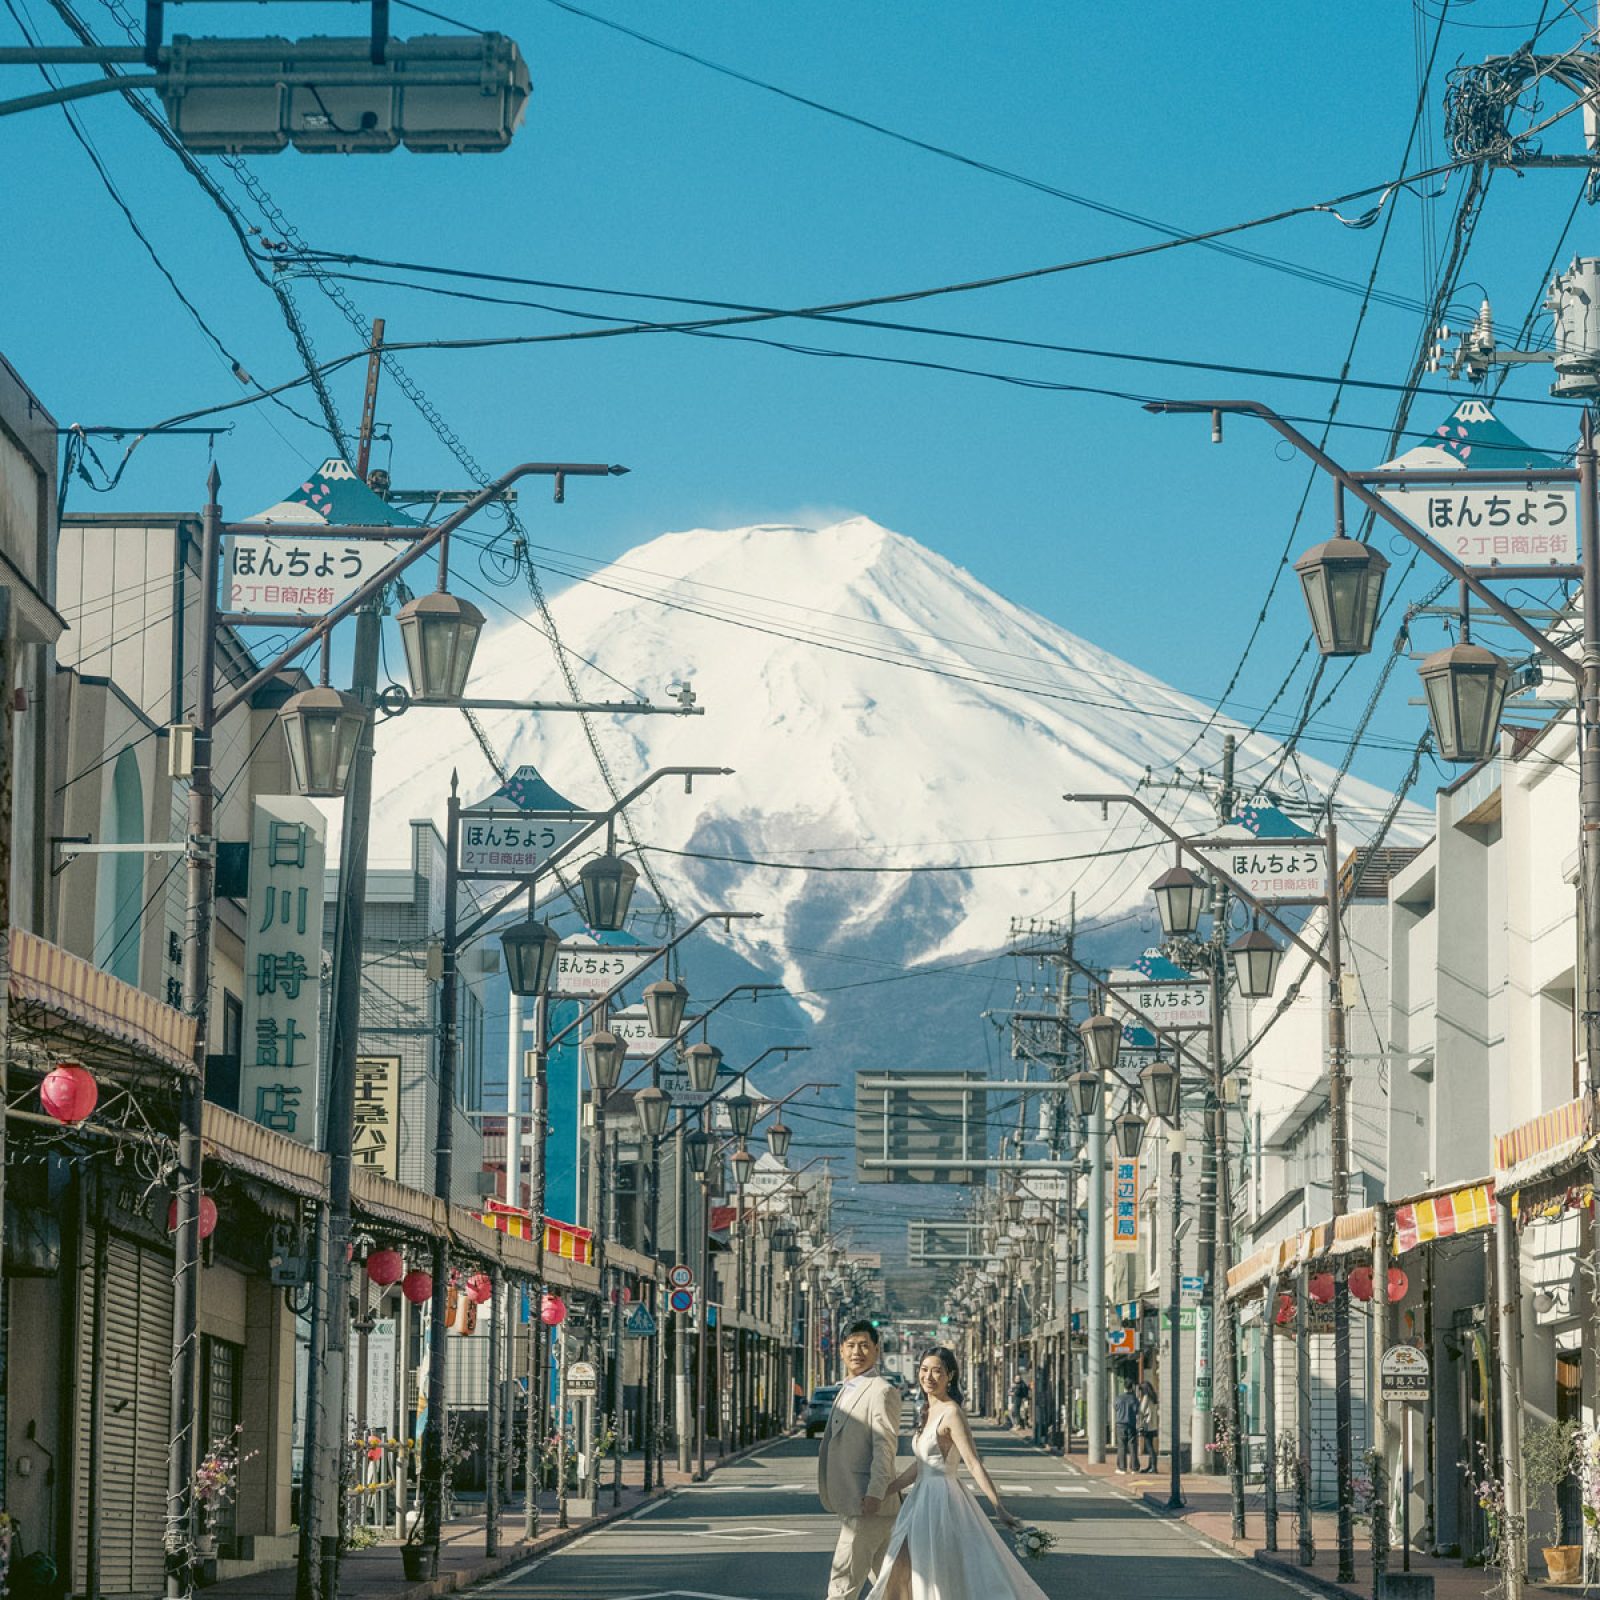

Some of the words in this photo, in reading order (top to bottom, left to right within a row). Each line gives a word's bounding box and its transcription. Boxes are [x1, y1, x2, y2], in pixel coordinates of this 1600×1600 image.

[1429, 494, 1568, 528] ほんちょう
[1457, 534, 1568, 555] 2丁目商店街
[232, 546, 362, 579] ほんちょう
[232, 584, 335, 604] 2丁目商店街
[467, 826, 556, 848] ほんちょう
[466, 852, 537, 865] 2丁目商店街
[1232, 853, 1318, 874] ほんちょう
[1251, 879, 1319, 891] 2丁目商店街
[559, 957, 625, 975] ほんちょう
[255, 821, 308, 1133] 日川時計店
[1140, 989, 1205, 1009] ほんちょう
[676, 1271, 689, 1281] 40
